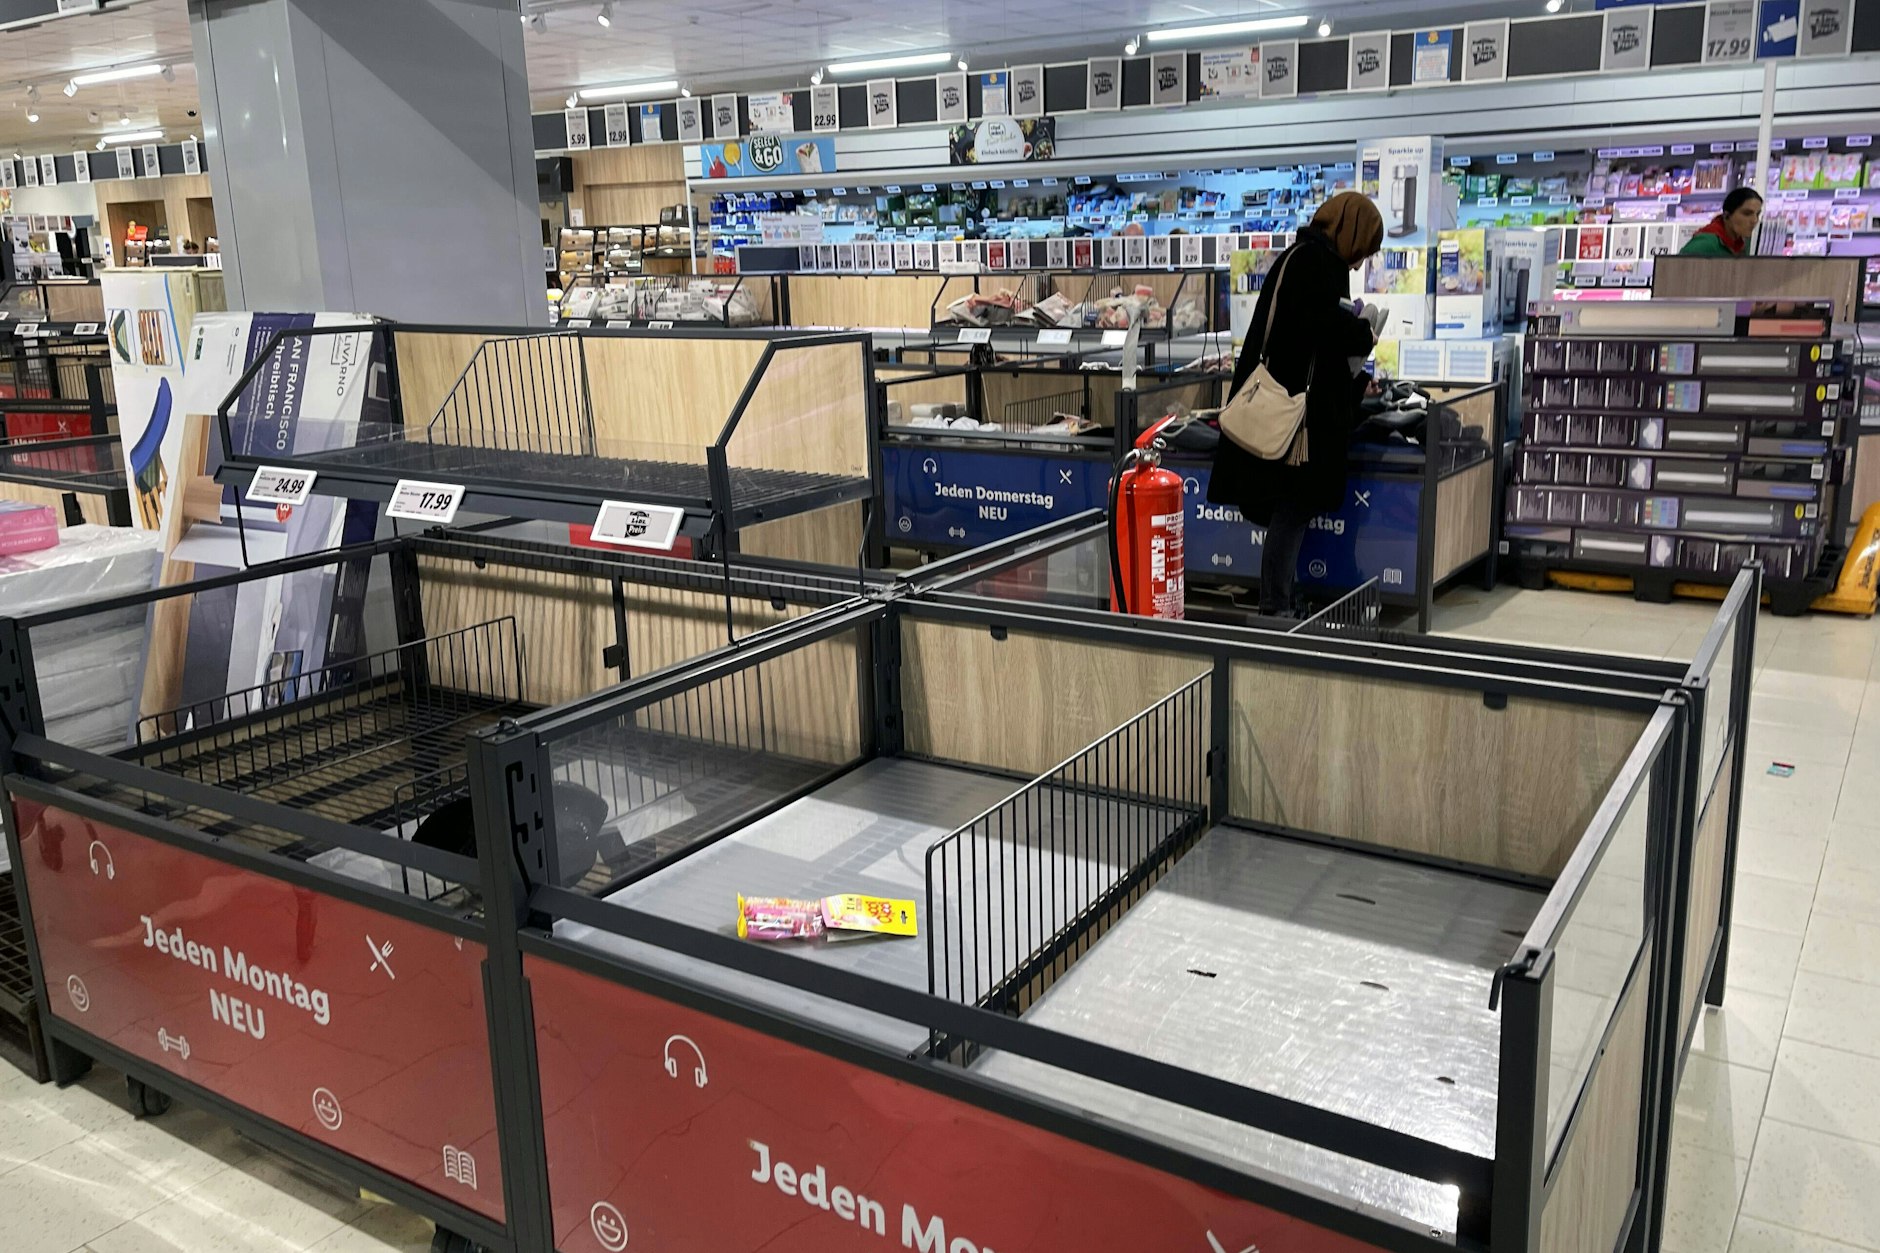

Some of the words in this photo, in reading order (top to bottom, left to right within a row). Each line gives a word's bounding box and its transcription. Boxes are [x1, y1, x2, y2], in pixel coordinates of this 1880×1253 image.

[1708, 37, 1751, 58] 17.99
[814, 114, 836, 127] 22.99
[571, 133, 586, 146] 5.99
[608, 129, 627, 143] 12.99
[755, 147, 783, 168] &GO
[1616, 247, 1634, 257] 6.79
[289, 335, 304, 360] AN
[336, 334, 353, 397] LIVARNO
[276, 362, 299, 451] FRANCISCO
[274, 477, 305, 494] 24.99
[934, 482, 973, 499] Jeden
[975, 485, 1054, 509] Donnerstag
[419, 492, 453, 510] 17.99
[978, 505, 1008, 521] NEU
[1196, 504, 1244, 522] Jeden
[140, 914, 218, 973] Jeden
[222, 945, 331, 1026] Montag
[209, 988, 266, 1040] NEU
[749, 1139, 886, 1237] Jeden
